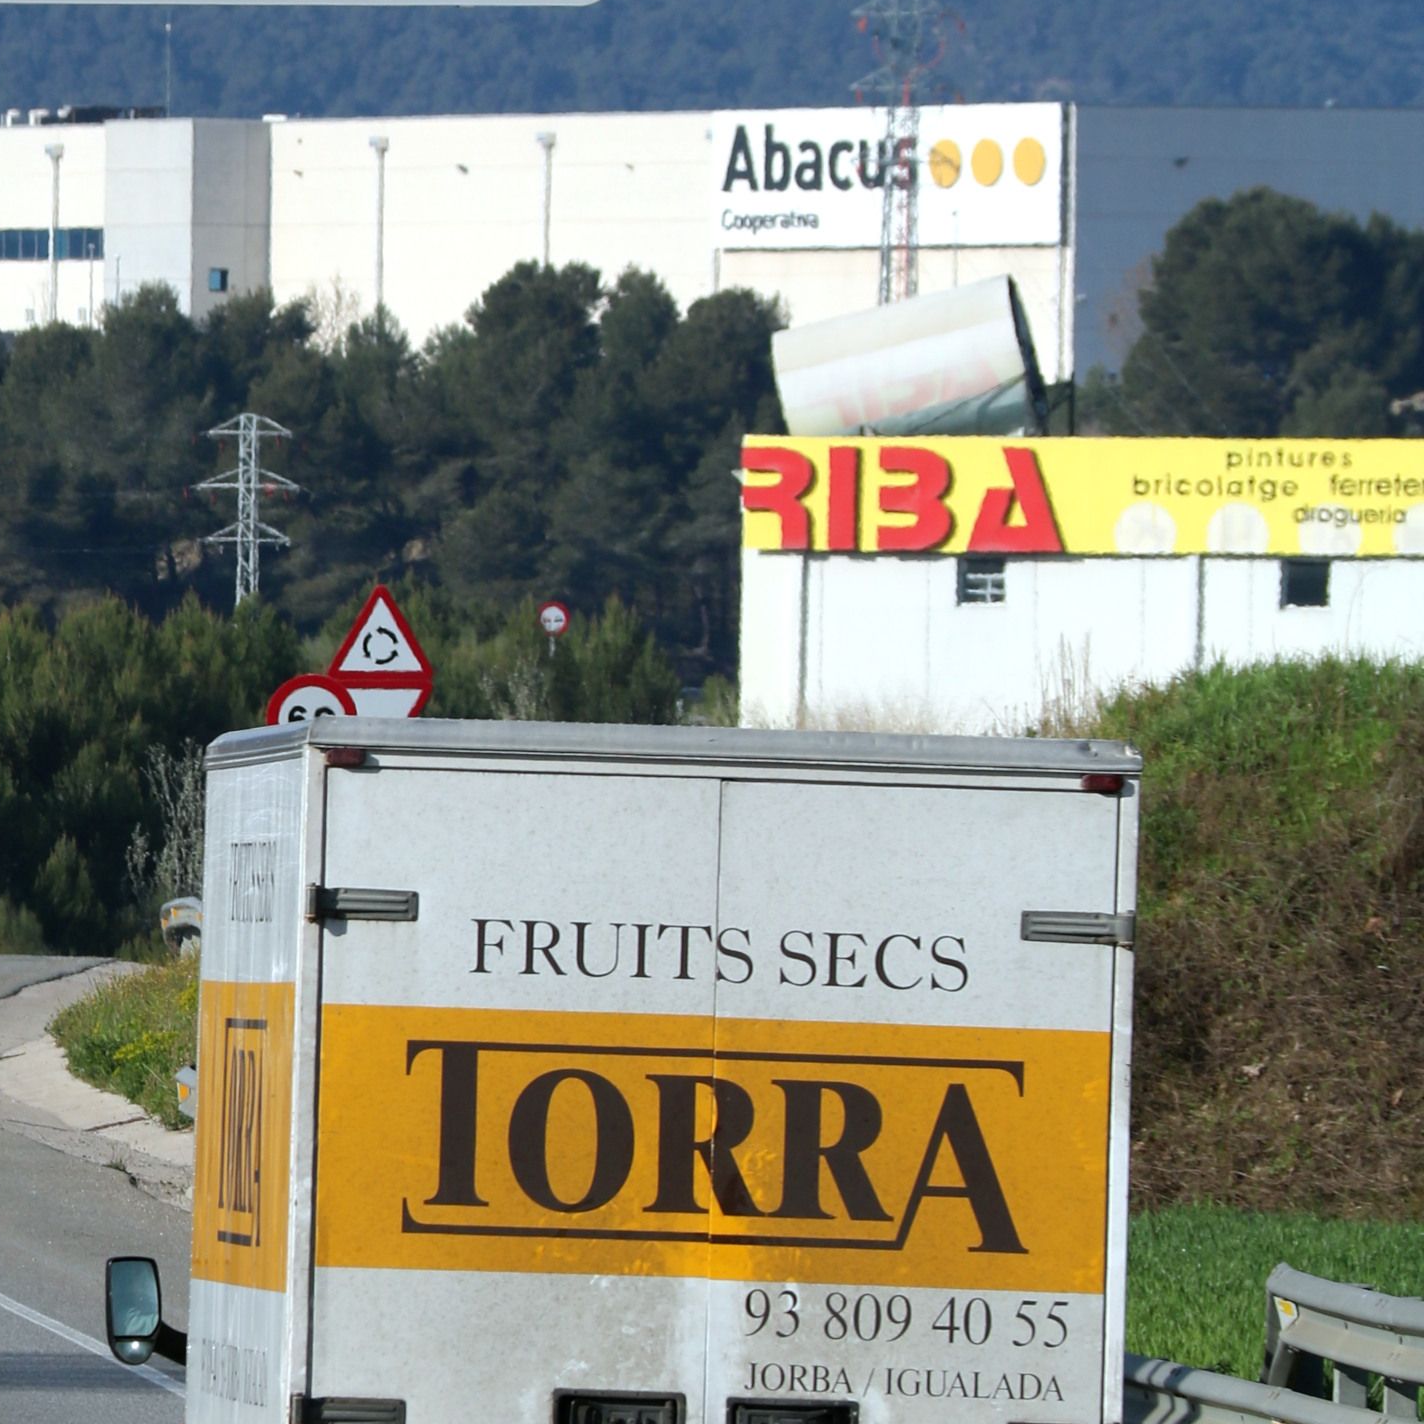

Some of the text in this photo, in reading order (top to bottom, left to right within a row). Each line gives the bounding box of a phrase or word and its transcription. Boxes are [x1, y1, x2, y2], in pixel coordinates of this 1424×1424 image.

[723, 123, 917, 192] Abacus
[722, 209, 819, 234] Cooperativa
[1133, 474, 1424, 501] bricolatge ferrete
[1226, 448, 1353, 468] pintures
[742, 446, 1066, 553] RIBA
[470, 918, 968, 992] FRUITS SECS
[404, 1038, 1029, 1256] TORRA
[745, 1289, 1069, 1348] 93 809 40 55
[744, 1362, 853, 1394] JORBA
[886, 1367, 1064, 1402] IGUALADA
